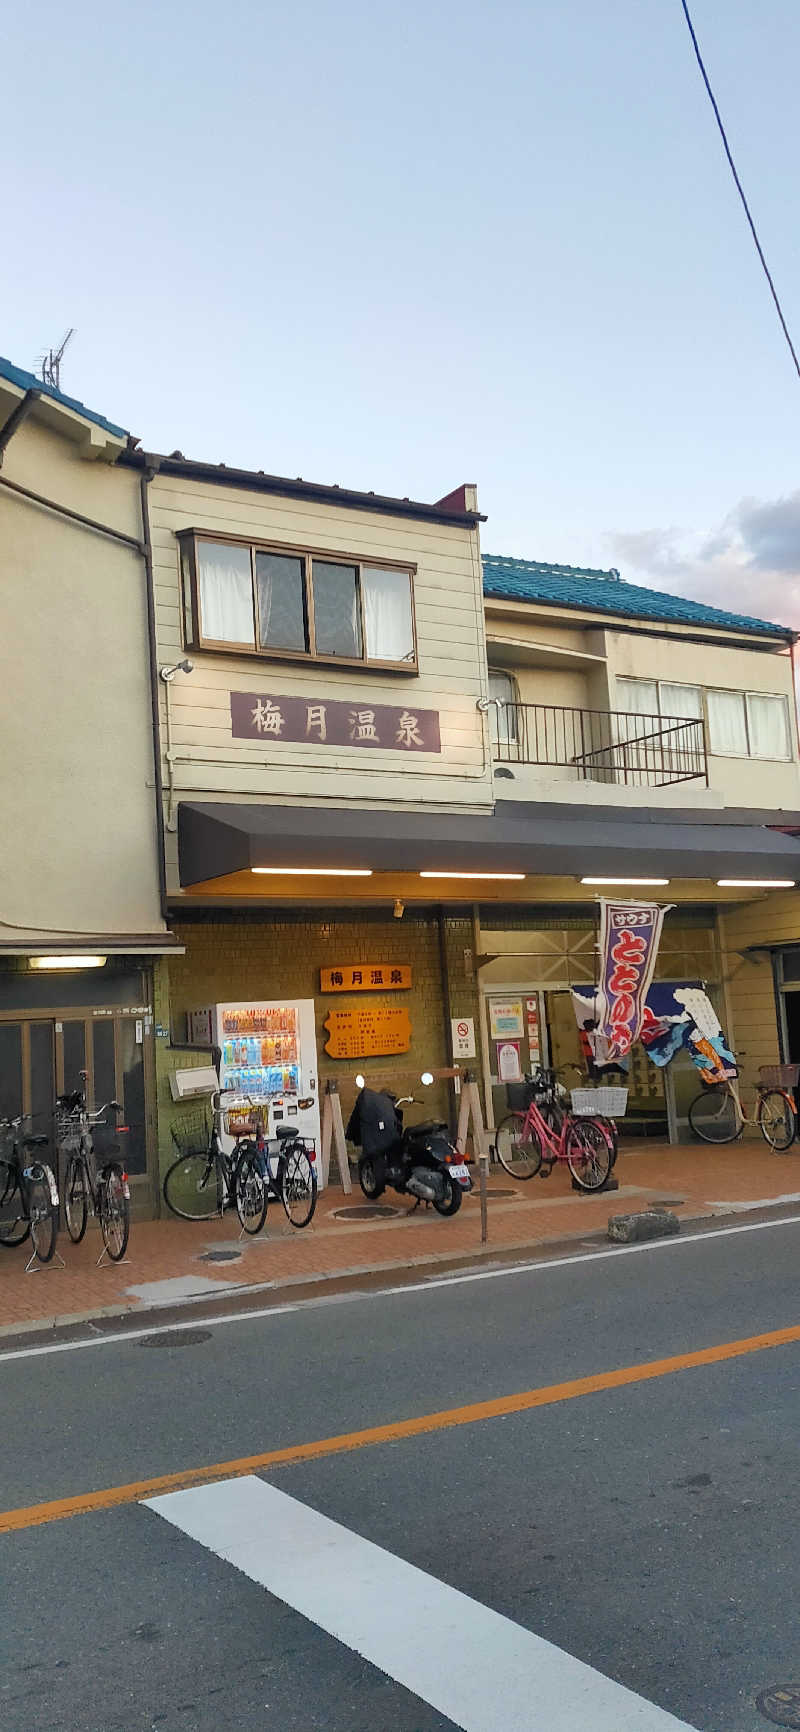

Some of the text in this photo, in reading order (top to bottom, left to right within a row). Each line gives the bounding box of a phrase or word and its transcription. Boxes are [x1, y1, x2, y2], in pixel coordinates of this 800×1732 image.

[251, 699, 424, 746] 梅月温泉
[614, 913, 650, 926] サウナ
[330, 969, 402, 986] 梅月温泉
